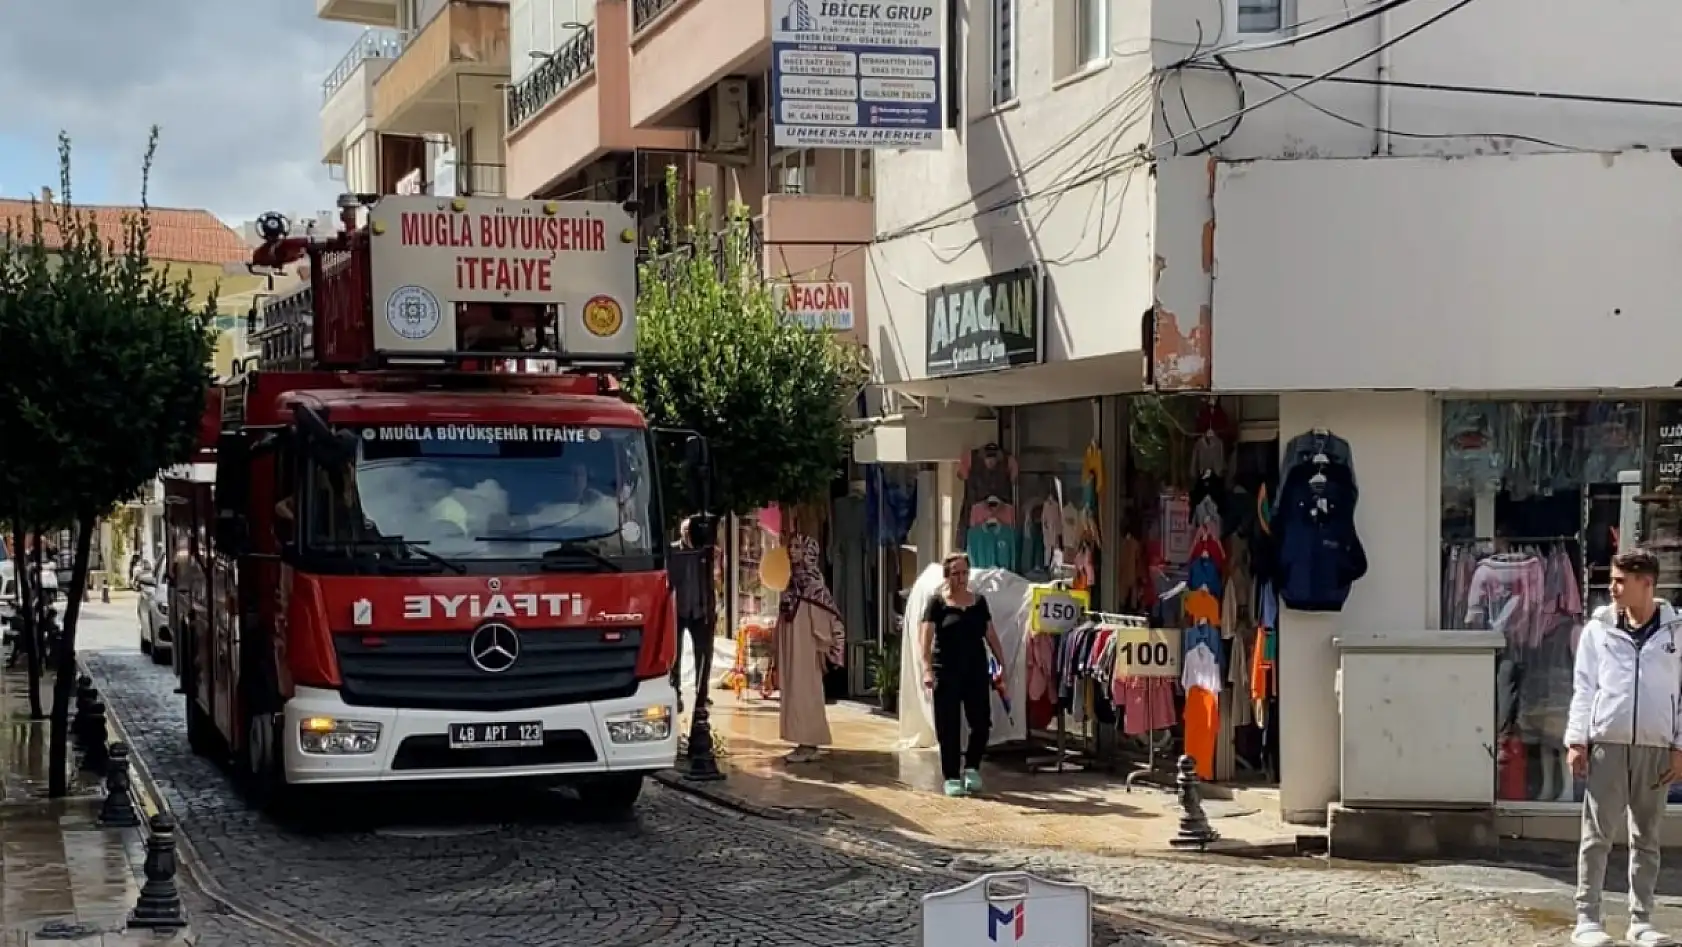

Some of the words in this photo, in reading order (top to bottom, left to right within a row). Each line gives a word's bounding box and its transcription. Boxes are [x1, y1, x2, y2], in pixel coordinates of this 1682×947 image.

[819, 0, 881, 19] İBİCEK
[886, 5, 933, 21] GRUP
[871, 130, 934, 141] MERMER
[401, 204, 474, 247] MUĞLA
[480, 207, 605, 259] BÜYÜKŞEHİR
[783, 284, 849, 310] AFACAN
[930, 277, 1033, 355] AFACAN
[379, 425, 433, 441] MUĞLA
[436, 424, 529, 444] BÜYÜKŞEHİR
[532, 424, 585, 443] İTFAİYE
[1041, 602, 1075, 621] 150
[484, 724, 508, 742] APT
[519, 724, 541, 741] 123
